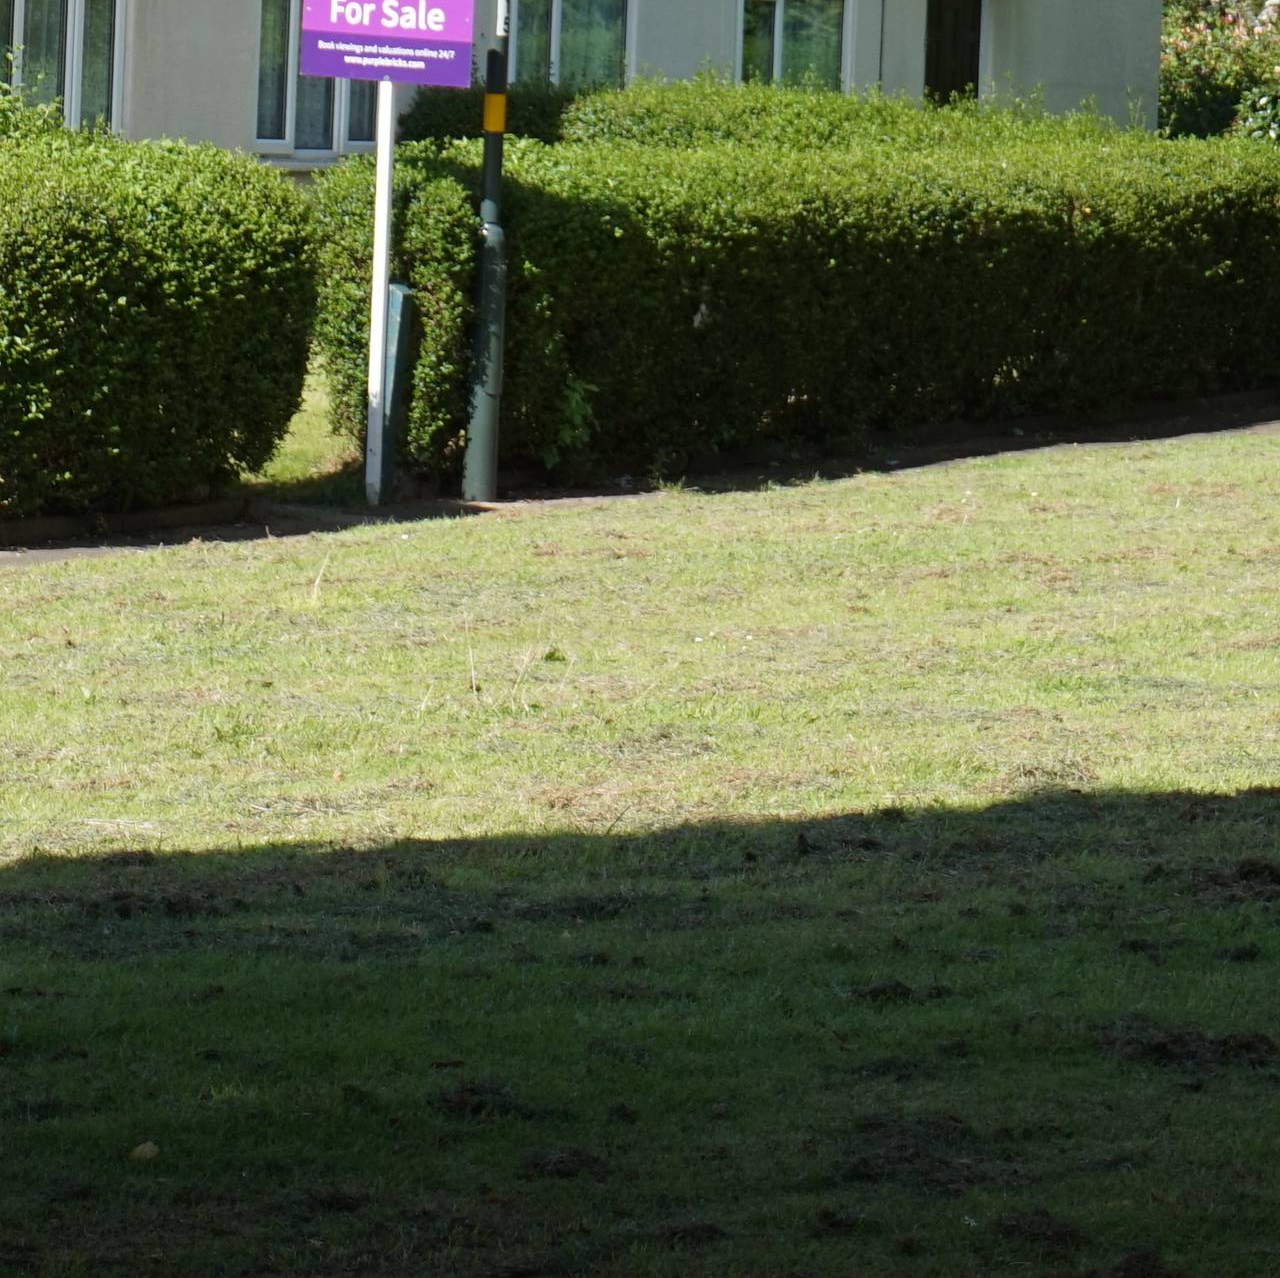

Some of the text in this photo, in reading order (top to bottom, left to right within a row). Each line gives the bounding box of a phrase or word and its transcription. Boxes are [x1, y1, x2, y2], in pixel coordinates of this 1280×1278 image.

[318, 39, 455, 60] Book viewings and valuations online 24/7
[344, 55, 425, 69] www.purplebricks.com
